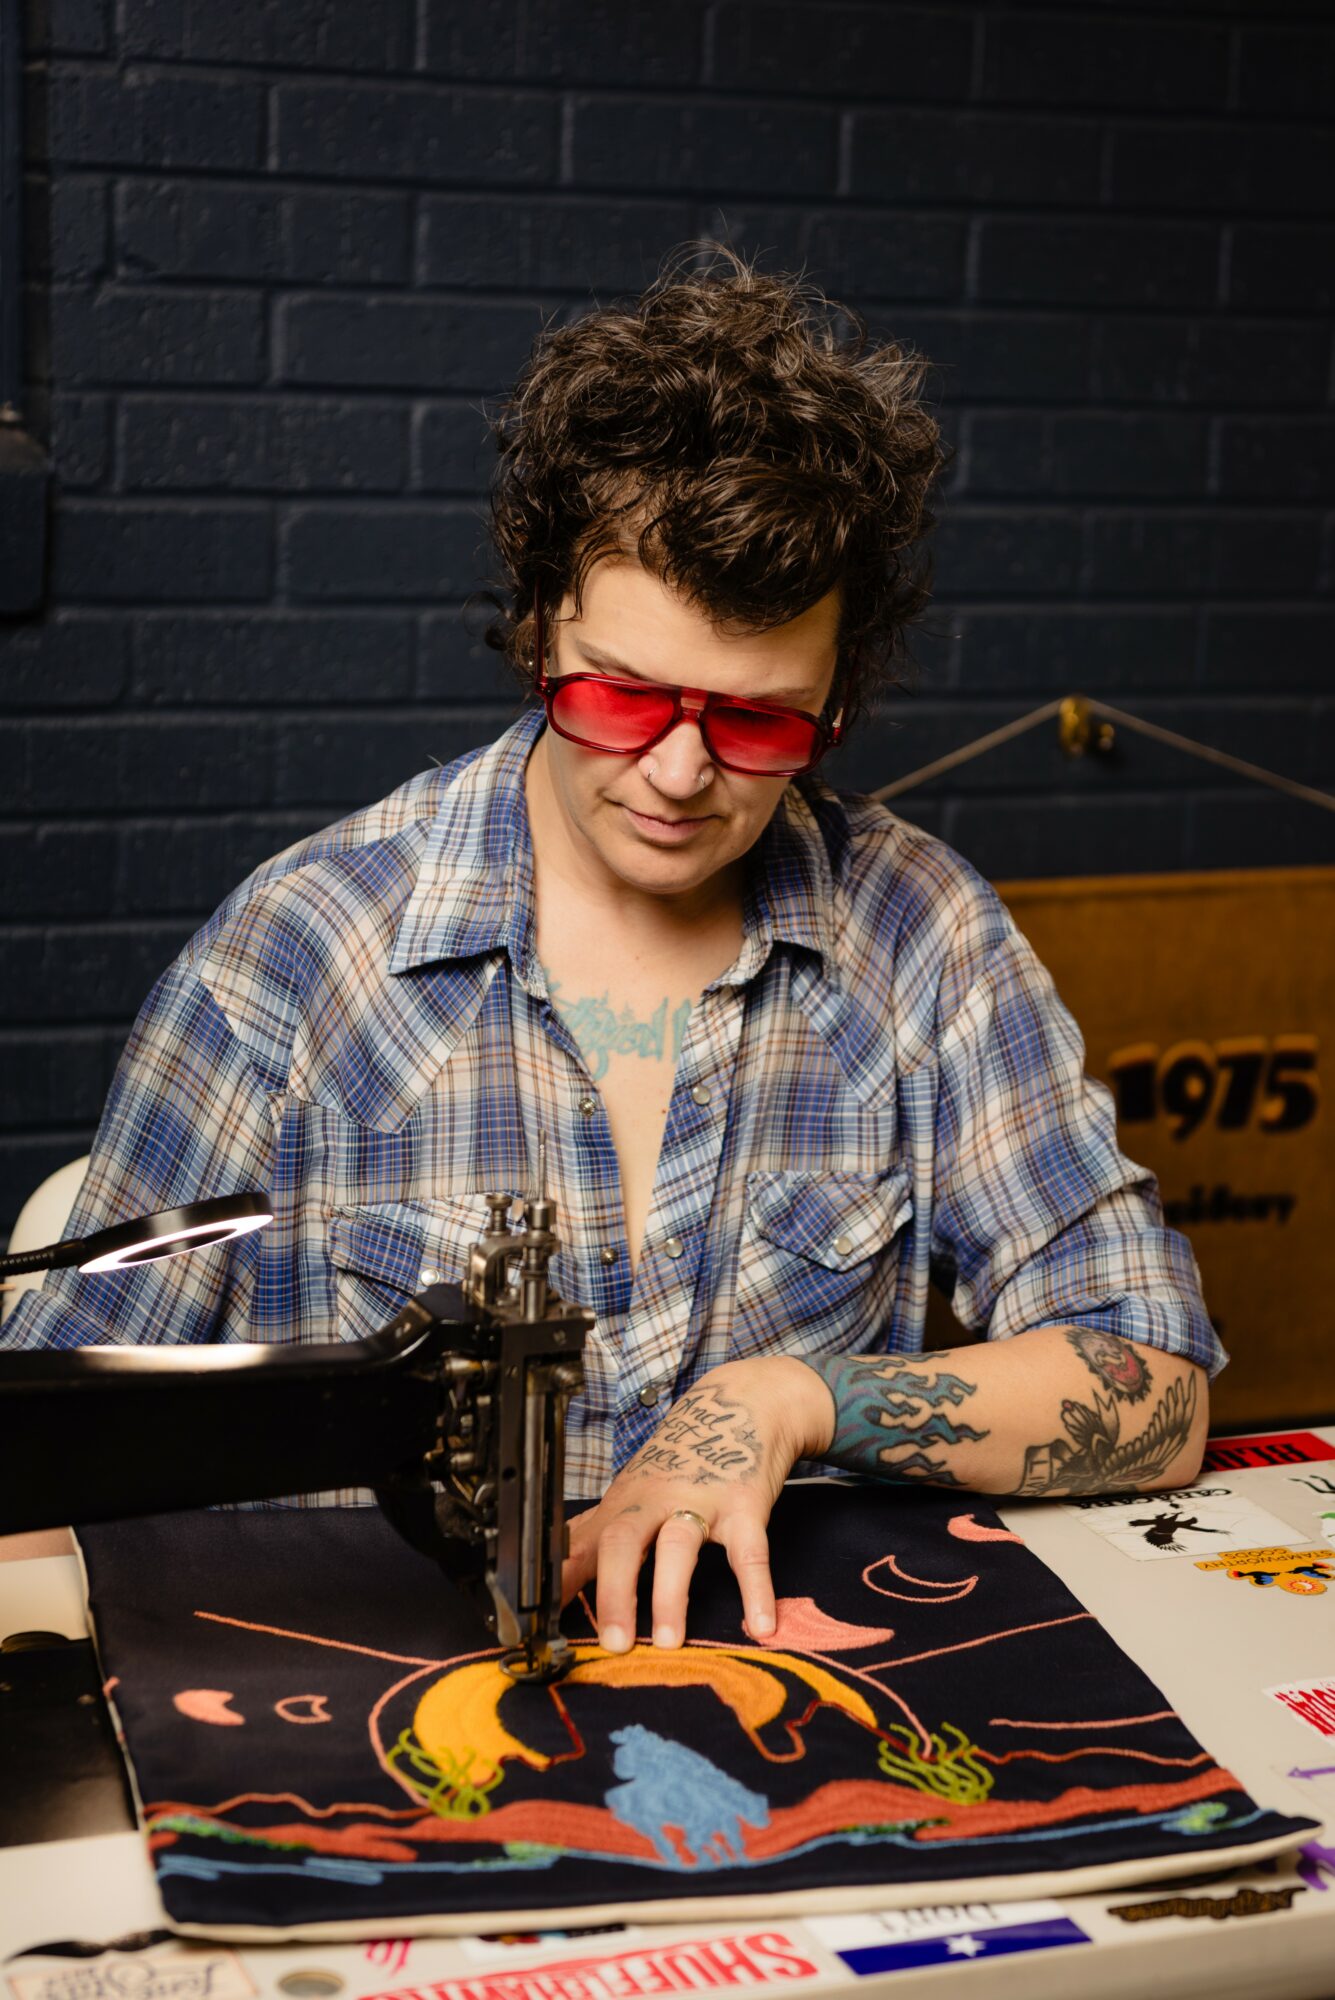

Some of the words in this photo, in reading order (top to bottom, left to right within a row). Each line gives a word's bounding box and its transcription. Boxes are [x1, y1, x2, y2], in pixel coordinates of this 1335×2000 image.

[1108, 1042, 1319, 1142] 1975
[627, 1444, 690, 1473] you
[688, 1434, 749, 1470] kill
[1203, 1550, 1333, 1570] STAMPWORTHY
[1224, 1548, 1289, 1560] GOODS
